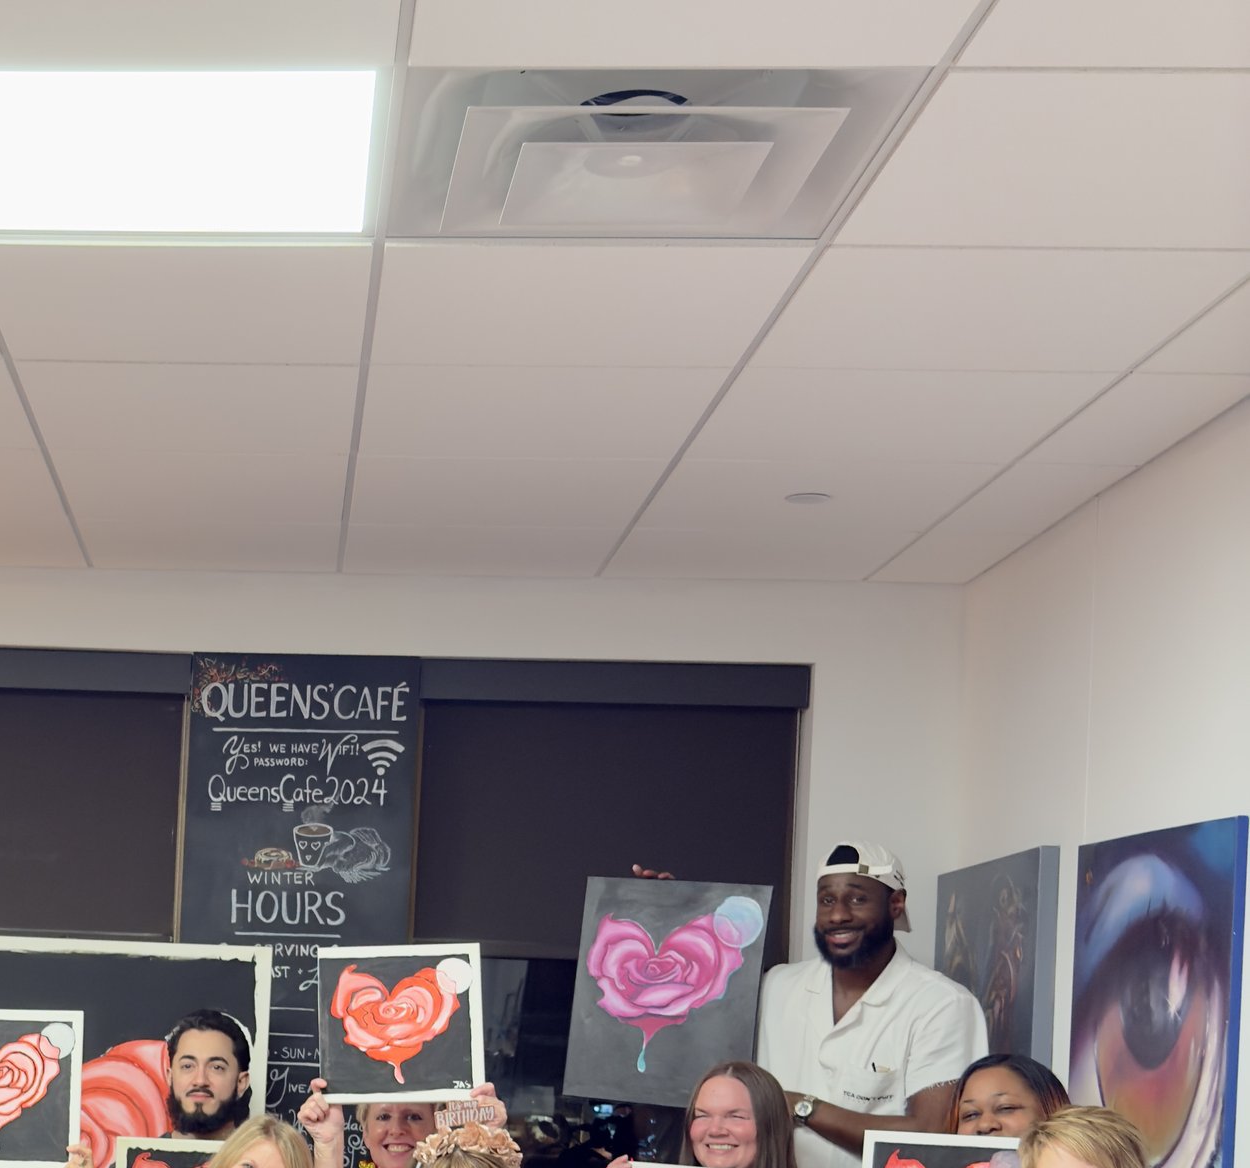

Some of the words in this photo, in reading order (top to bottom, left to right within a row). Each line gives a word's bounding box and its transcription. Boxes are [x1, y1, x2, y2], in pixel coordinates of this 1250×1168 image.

[269, 743, 286, 754] WE
[291, 743, 319, 754] HAVE
[208, 773, 387, 806] QueensCafe2024
[247, 871, 315, 886] WINTER
[230, 888, 346, 926] HOURS
[280, 1046, 306, 1060] SUN
[435, 1105, 495, 1127] BIRTHDAY
